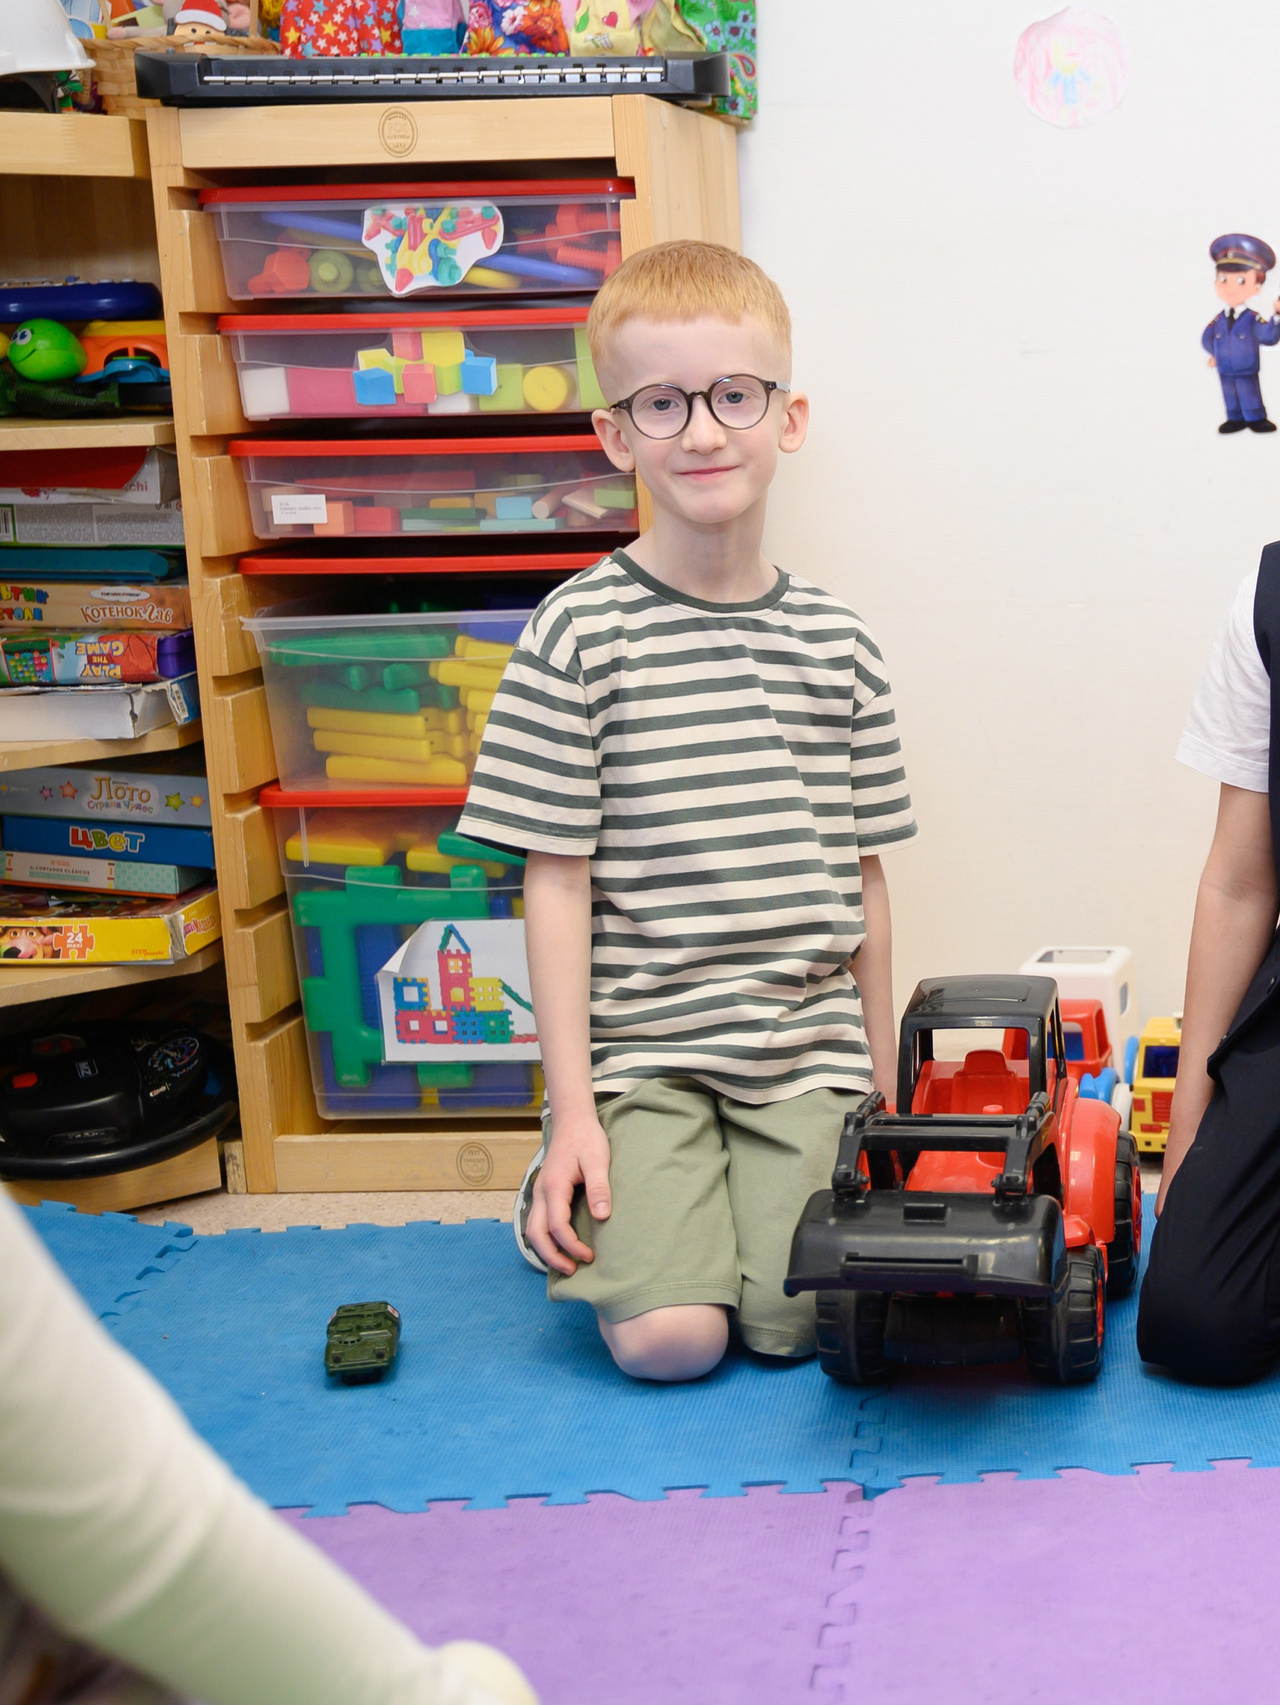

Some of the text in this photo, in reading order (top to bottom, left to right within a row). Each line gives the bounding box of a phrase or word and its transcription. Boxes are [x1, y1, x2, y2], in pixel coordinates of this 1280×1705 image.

[0, 585, 49, 604] ЬТИК
[75, 641, 125, 655] GAME
[80, 663, 122, 679] PLAY
[87, 800, 154, 814] Страна Чудес
[67, 932, 83, 943] 24
